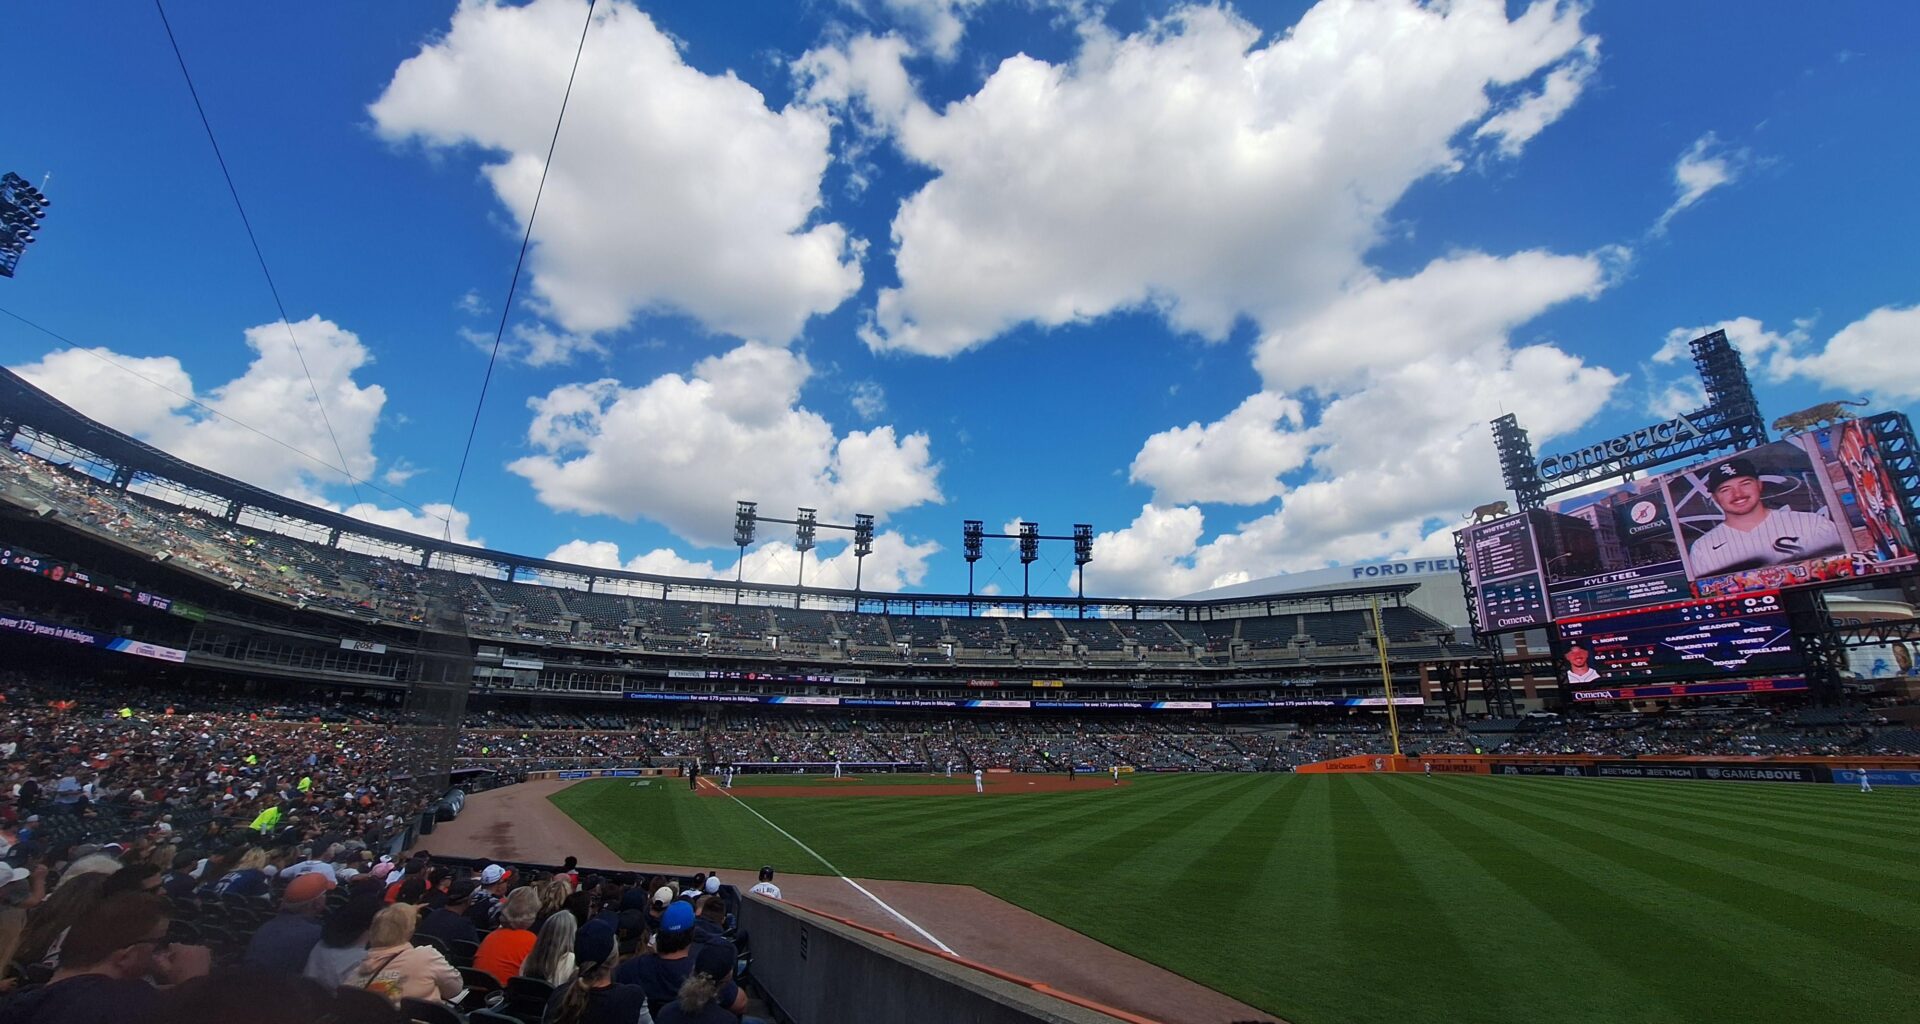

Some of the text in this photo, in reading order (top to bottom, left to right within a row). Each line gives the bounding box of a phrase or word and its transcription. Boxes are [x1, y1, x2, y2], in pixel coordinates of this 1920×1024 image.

[1580, 450, 1656, 480] PARK
[1482, 519, 1520, 534] WHITE SOX
[1352, 559, 1460, 578] FORD FIEL
[1584, 571, 1640, 586] KYLE TEEL
[1744, 596, 1775, 606] 0-0
[0, 618, 95, 643] over 175 years in Michigan.
[1699, 622, 1740, 631] MEADOWS
[1666, 632, 1710, 642] CARPENTER
[1738, 646, 1791, 655] TORKELSON
[1722, 770, 1801, 780] GAMEABOVE
